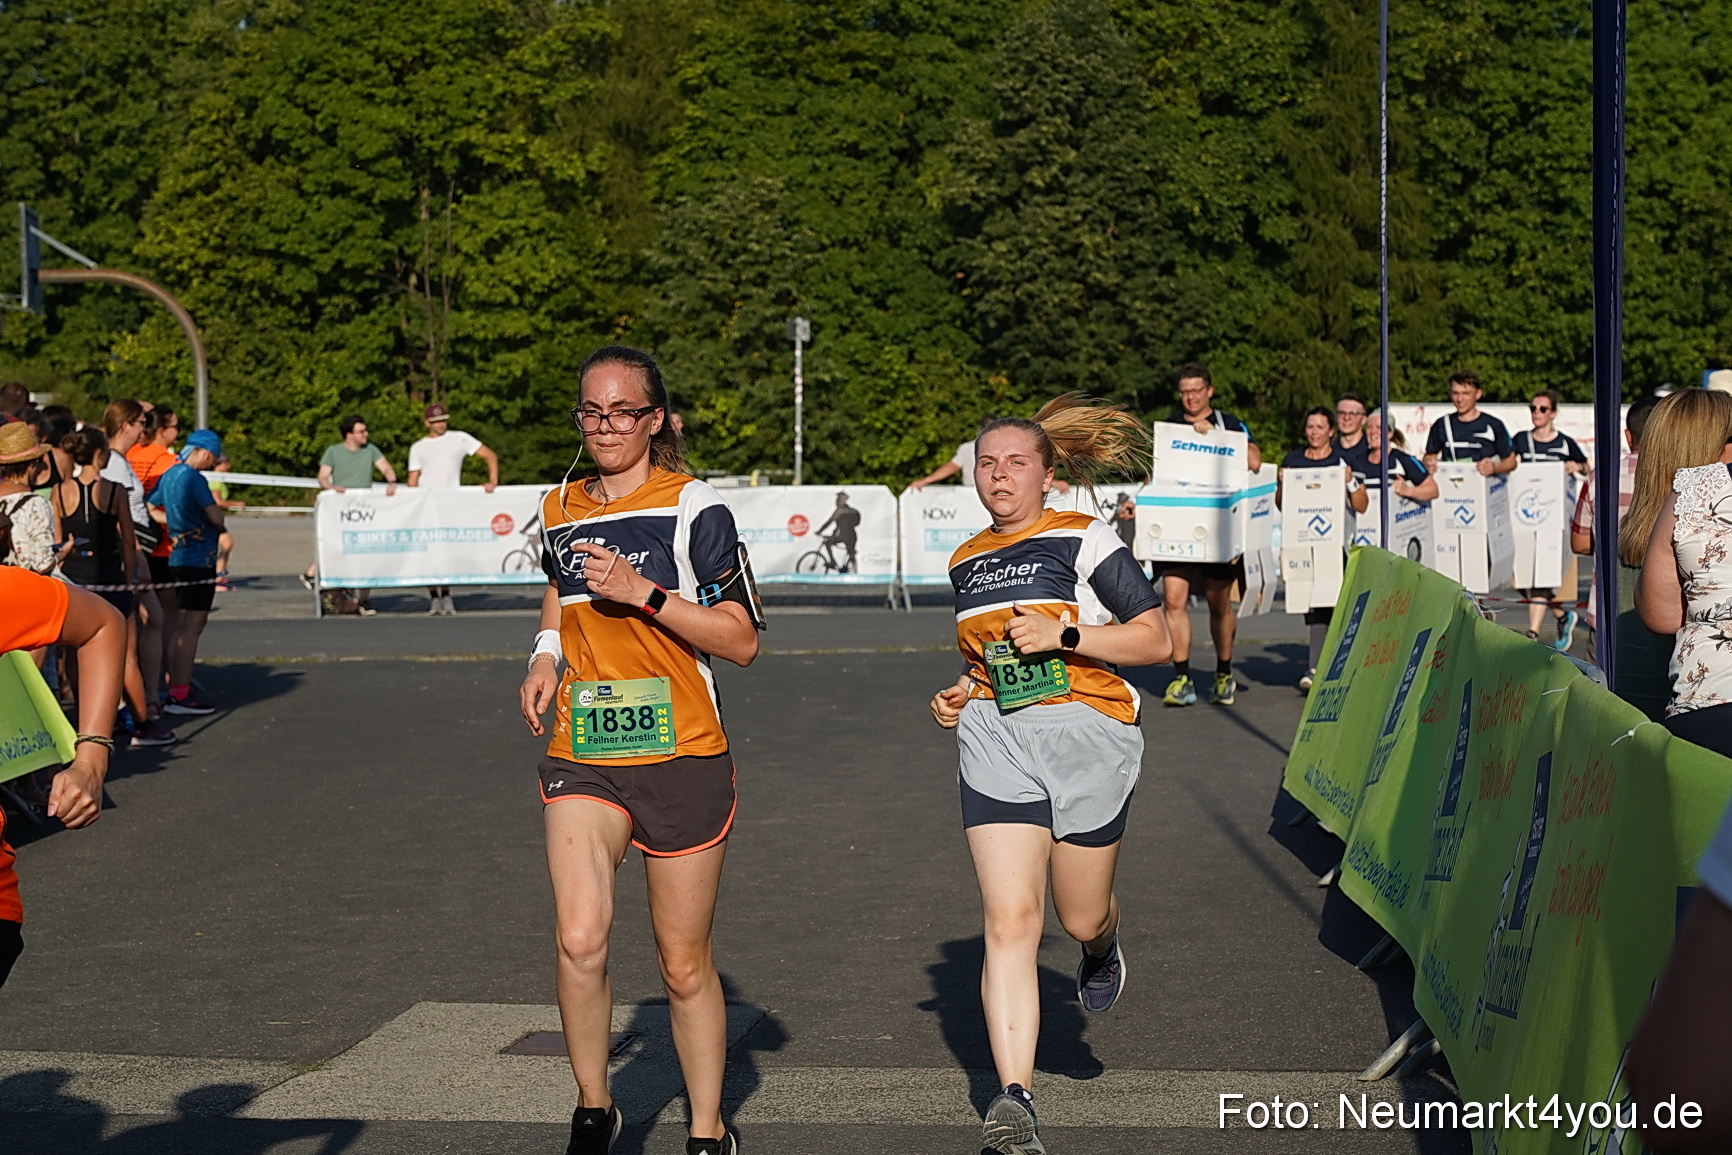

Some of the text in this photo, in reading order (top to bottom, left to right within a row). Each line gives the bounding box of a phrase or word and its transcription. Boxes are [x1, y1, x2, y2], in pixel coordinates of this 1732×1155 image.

[1171, 439, 1236, 457] Schmidt
[340, 508, 376, 523] NOW
[922, 508, 958, 521] NOW
[967, 562, 1043, 588] Fischer
[970, 577, 1034, 595] AUTOMOBILE
[991, 661, 1048, 687] 1831
[1022, 679, 1054, 693] Martina
[593, 693, 624, 703] Firmenlauf
[587, 705, 656, 733] 1838
[657, 707, 670, 743] 2022
[576, 717, 585, 744] RUN
[587, 733, 657, 745] Fellner Kerstin
